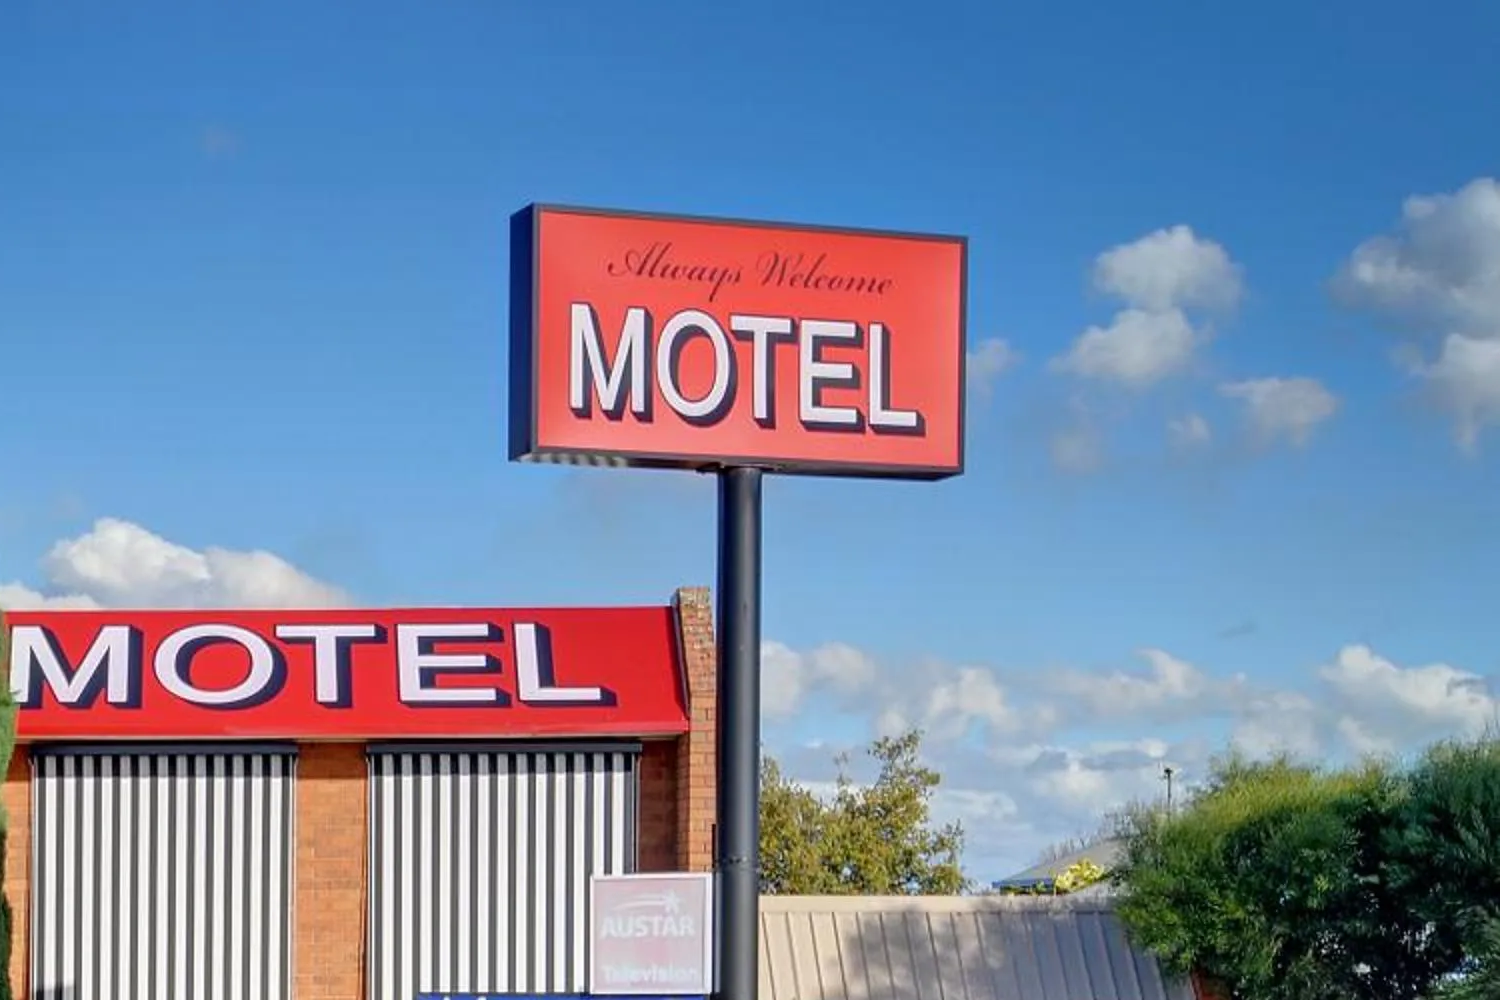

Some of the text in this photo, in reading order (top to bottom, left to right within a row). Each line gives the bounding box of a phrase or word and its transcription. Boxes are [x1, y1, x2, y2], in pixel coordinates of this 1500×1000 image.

[607, 242, 893, 302] Always Welcome
[569, 302, 926, 437] MOTEL
[9, 621, 612, 708] MOTEL
[601, 914, 696, 939] AUSTAR
